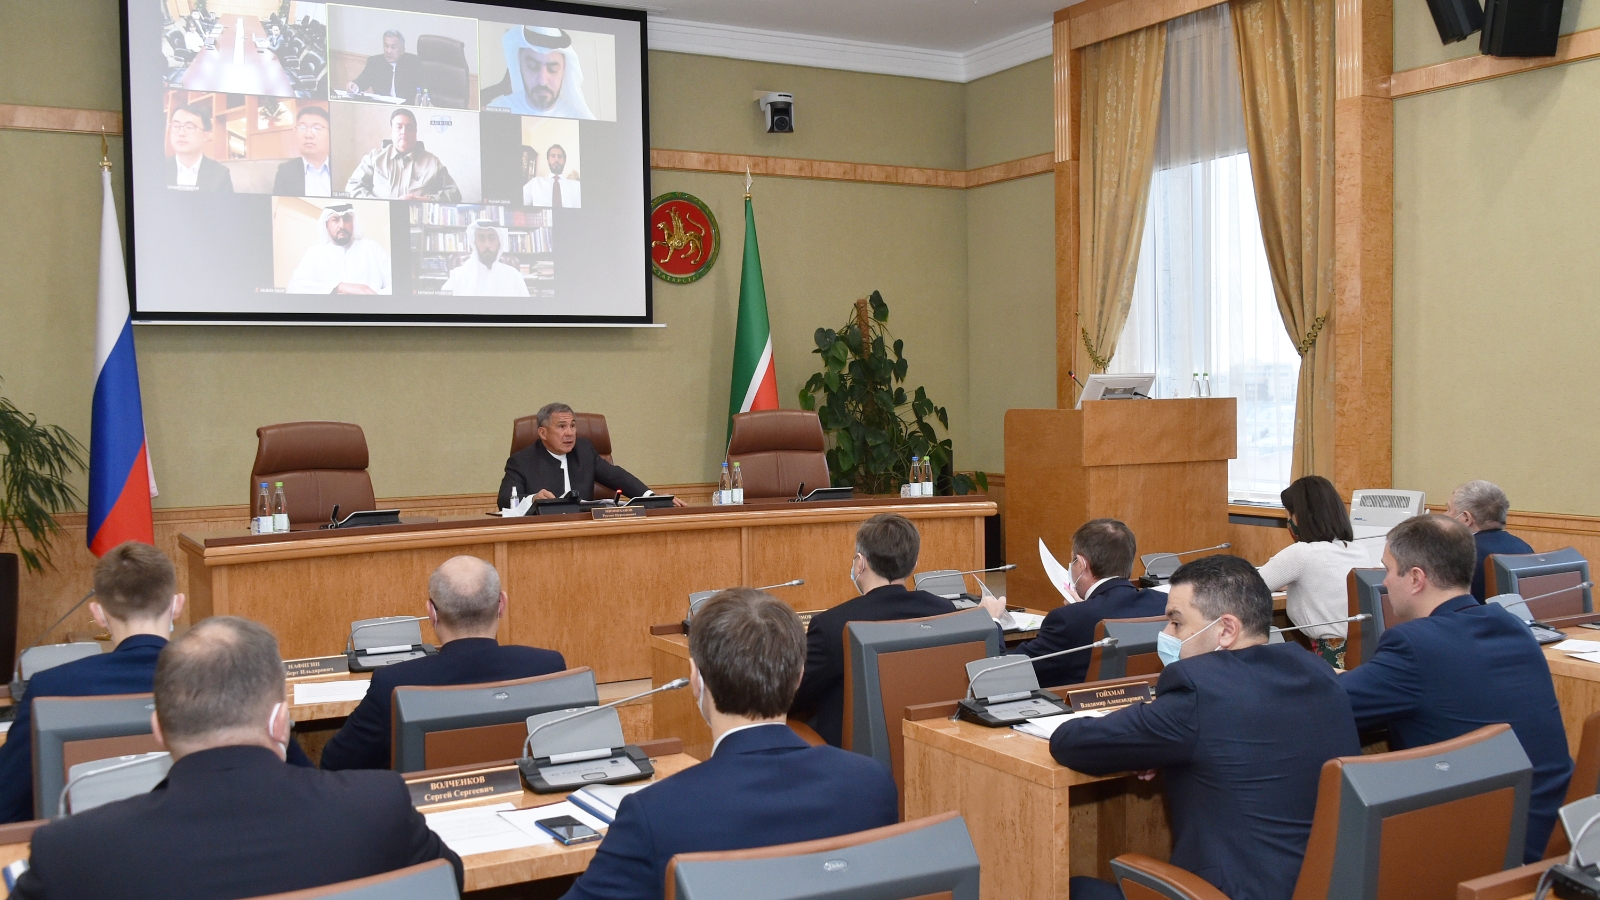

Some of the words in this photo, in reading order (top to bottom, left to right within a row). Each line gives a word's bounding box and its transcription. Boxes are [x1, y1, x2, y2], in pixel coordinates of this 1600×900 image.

[1095, 688, 1125, 699] ГОЙХМАН
[1079, 700, 1106, 709] Владимир
[1106, 695, 1144, 705] Александрович
[430, 775, 486, 791] ВОЛЧЕНКОВ
[424, 790, 453, 802] Сергей
[453, 785, 494, 798] Сергеевич
